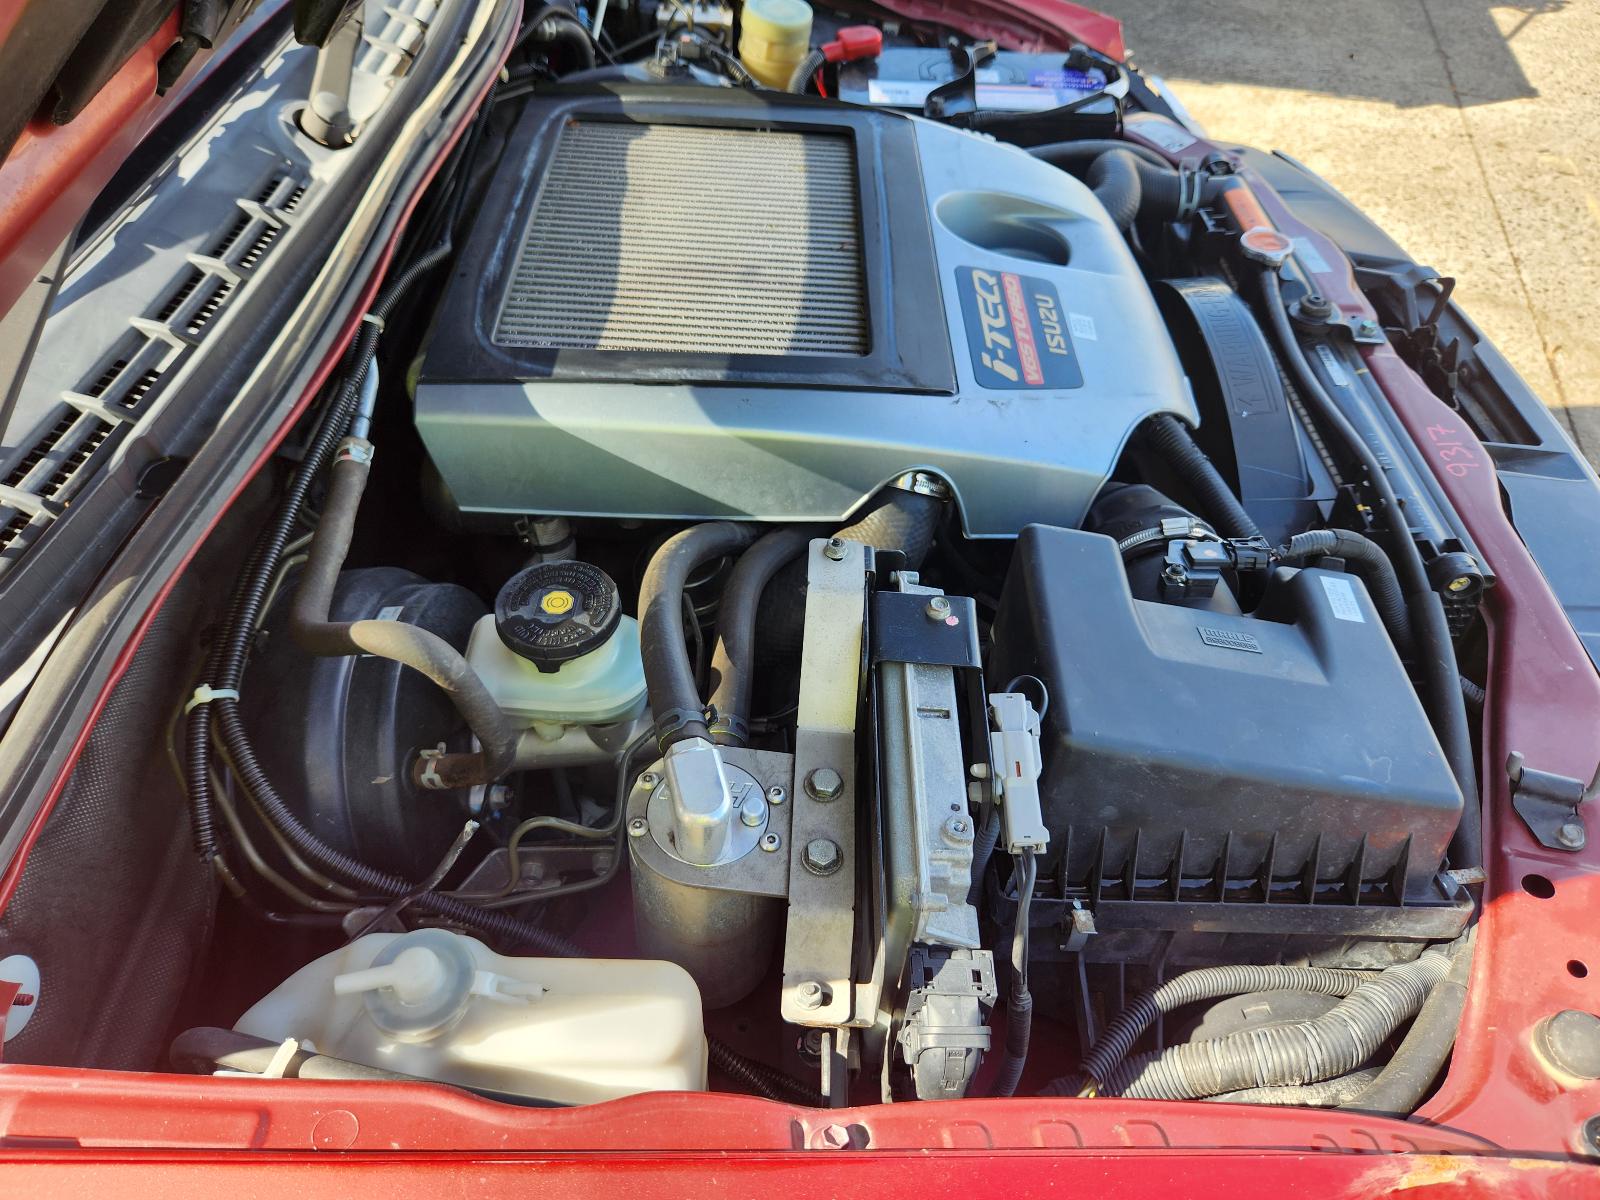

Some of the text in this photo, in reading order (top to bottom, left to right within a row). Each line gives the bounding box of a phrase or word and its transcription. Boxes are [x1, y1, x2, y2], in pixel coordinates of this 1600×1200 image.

[1006, 275, 1030, 341] TURBO
[1035, 295, 1067, 354] ISUZU
[1426, 423, 1480, 478] 9317
